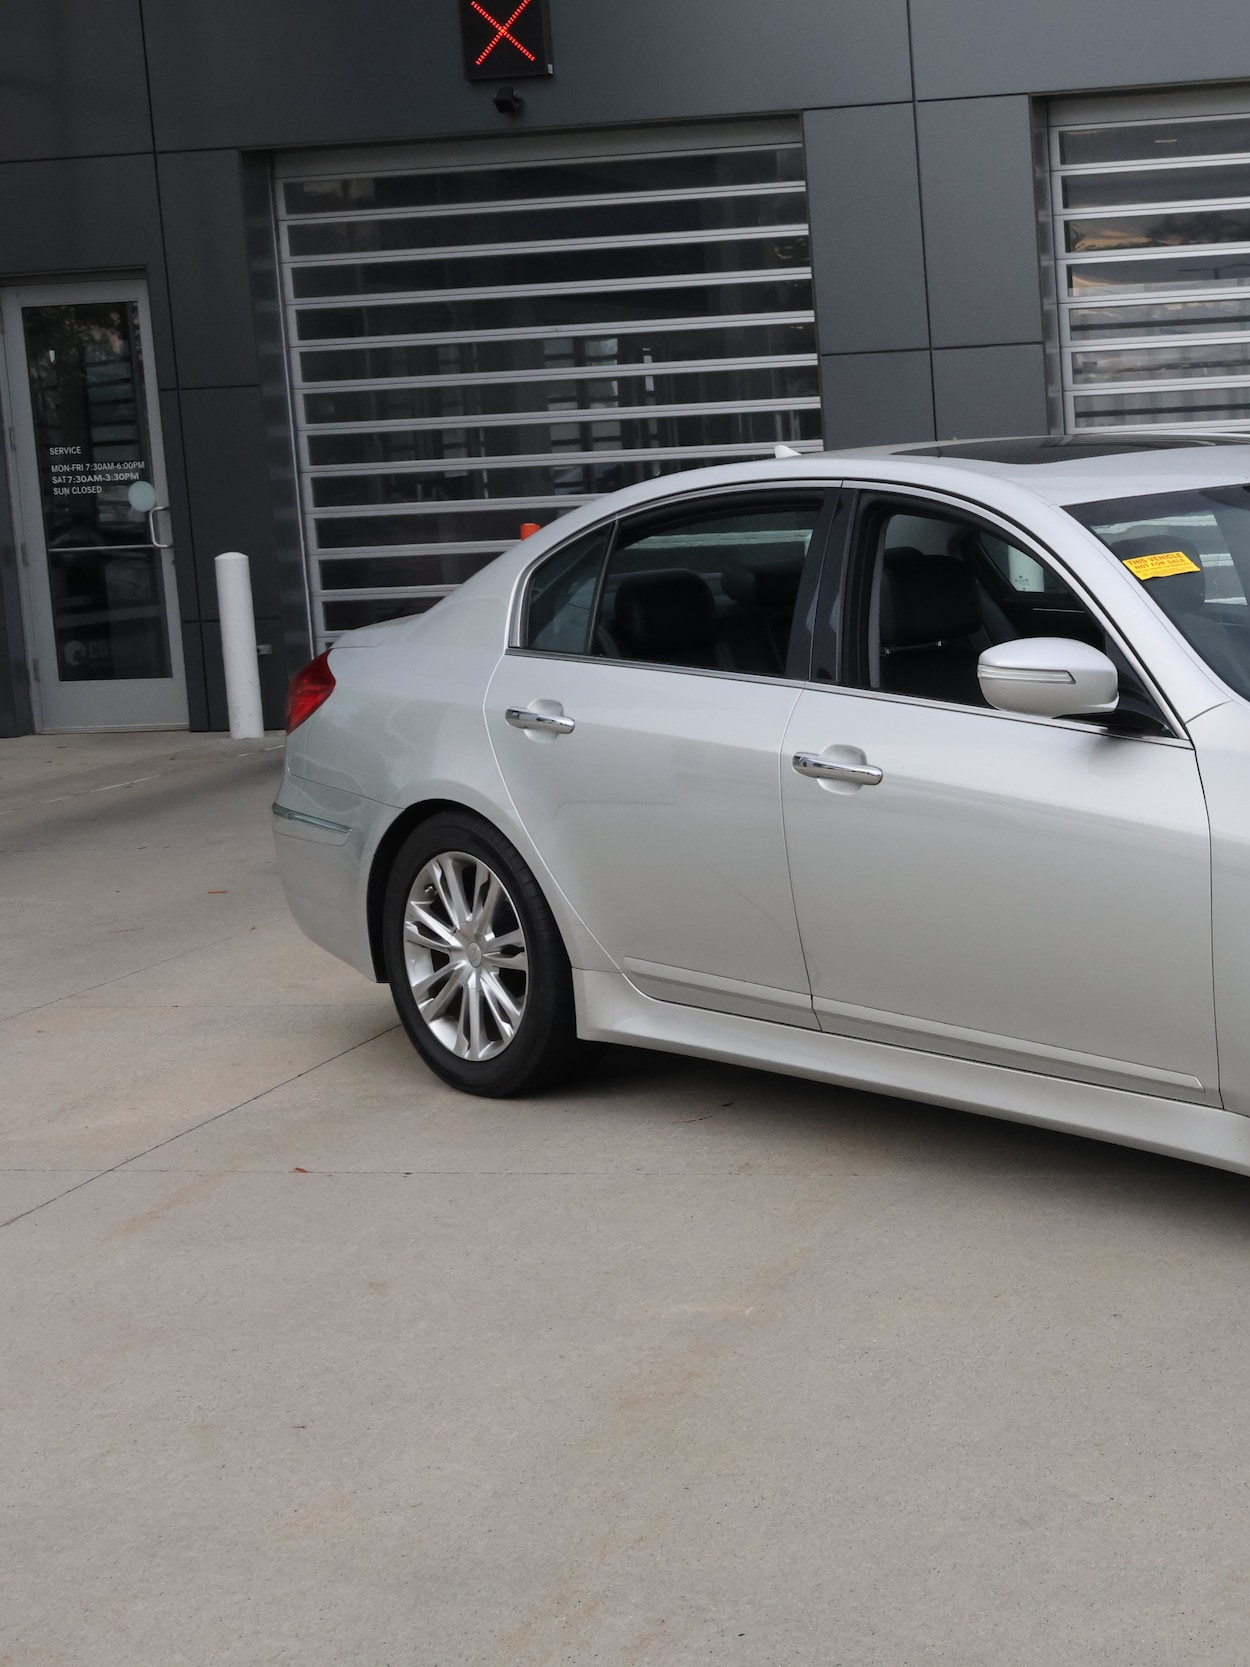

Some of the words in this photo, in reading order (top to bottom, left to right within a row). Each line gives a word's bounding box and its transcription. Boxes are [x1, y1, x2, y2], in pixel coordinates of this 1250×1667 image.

[49, 446, 82, 455] SERVICE
[51, 463, 84, 472] MON-FRI
[85, 461, 145, 471] 7:30AM-6:00PM
[52, 476, 67, 484] SAT
[68, 472, 139, 483] 7:30AM-3:30PM
[53, 487, 70, 496] SUN
[71, 485, 102, 495] CLOSED
[1128, 558, 1148, 566] THIS
[1148, 552, 1182, 562] VEHICLE
